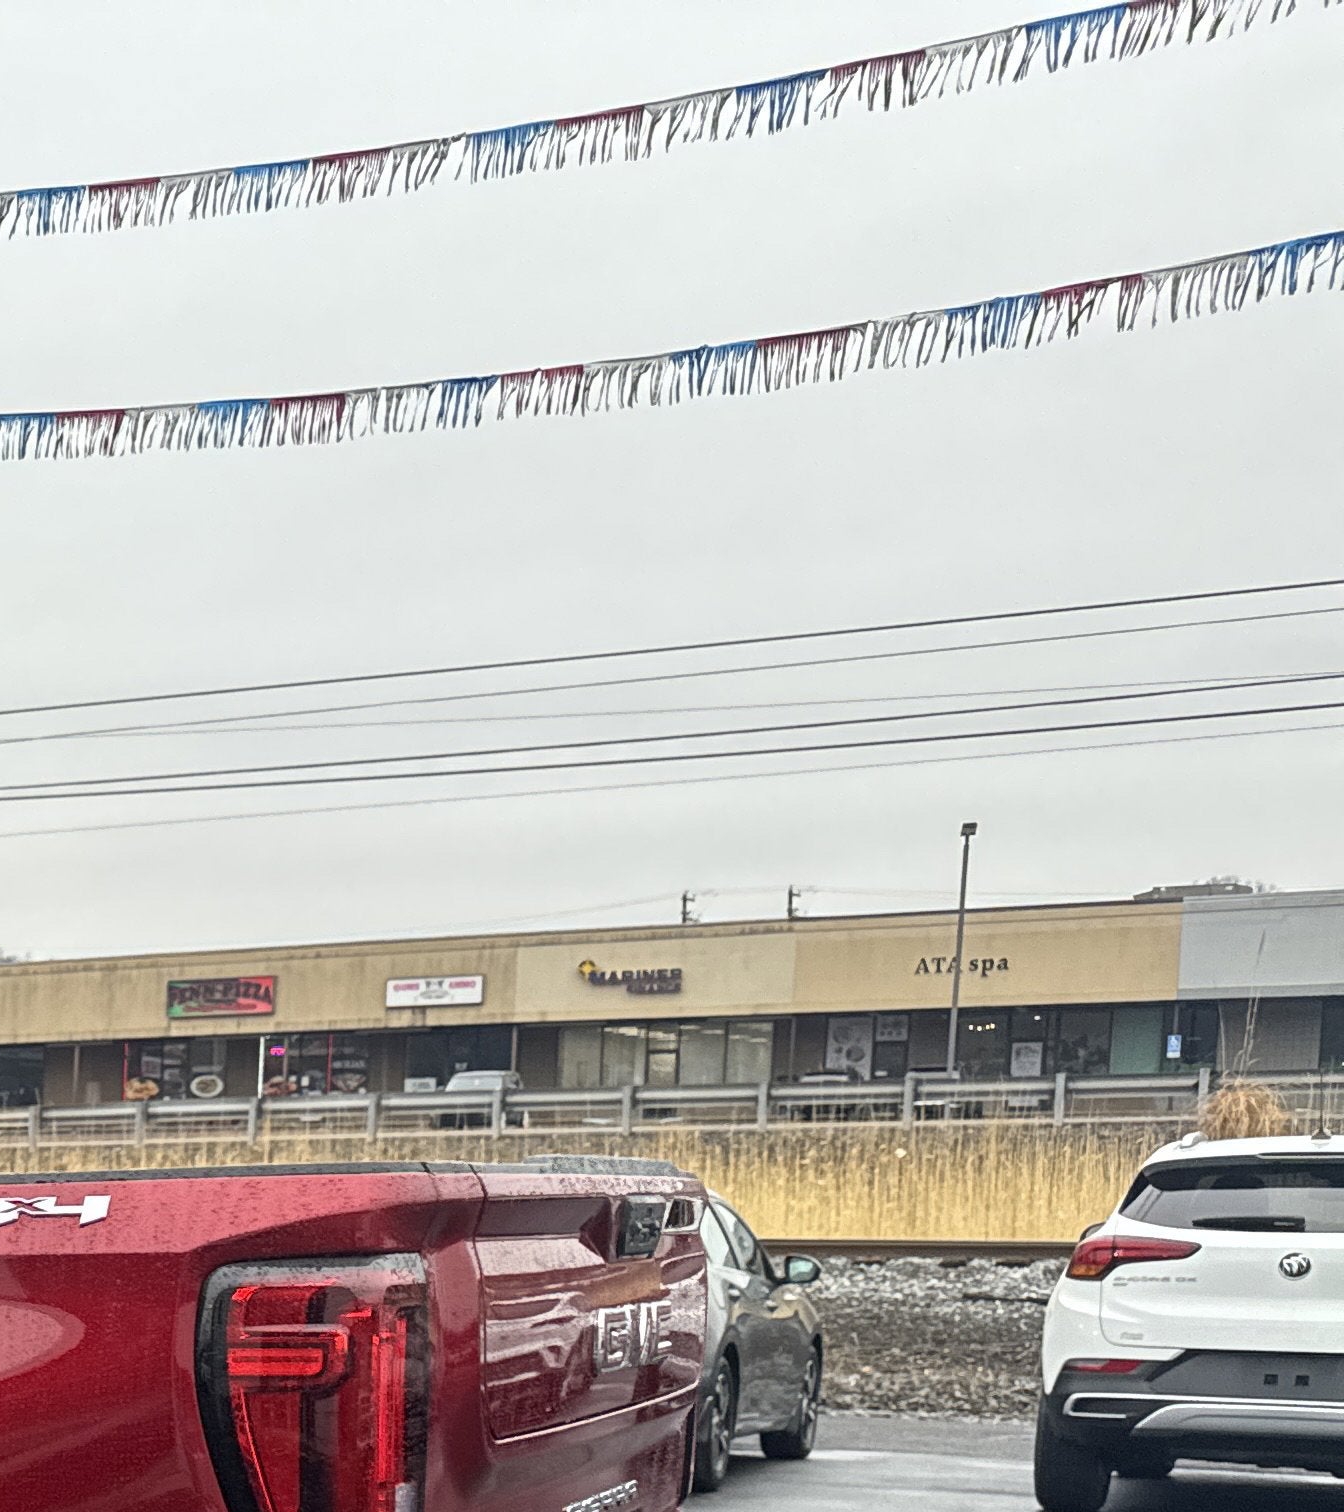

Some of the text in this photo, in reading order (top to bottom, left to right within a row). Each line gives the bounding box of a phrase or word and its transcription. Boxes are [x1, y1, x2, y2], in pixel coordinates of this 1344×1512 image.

[588, 968, 682, 986] MARINER
[914, 956, 1009, 978] ATA spa
